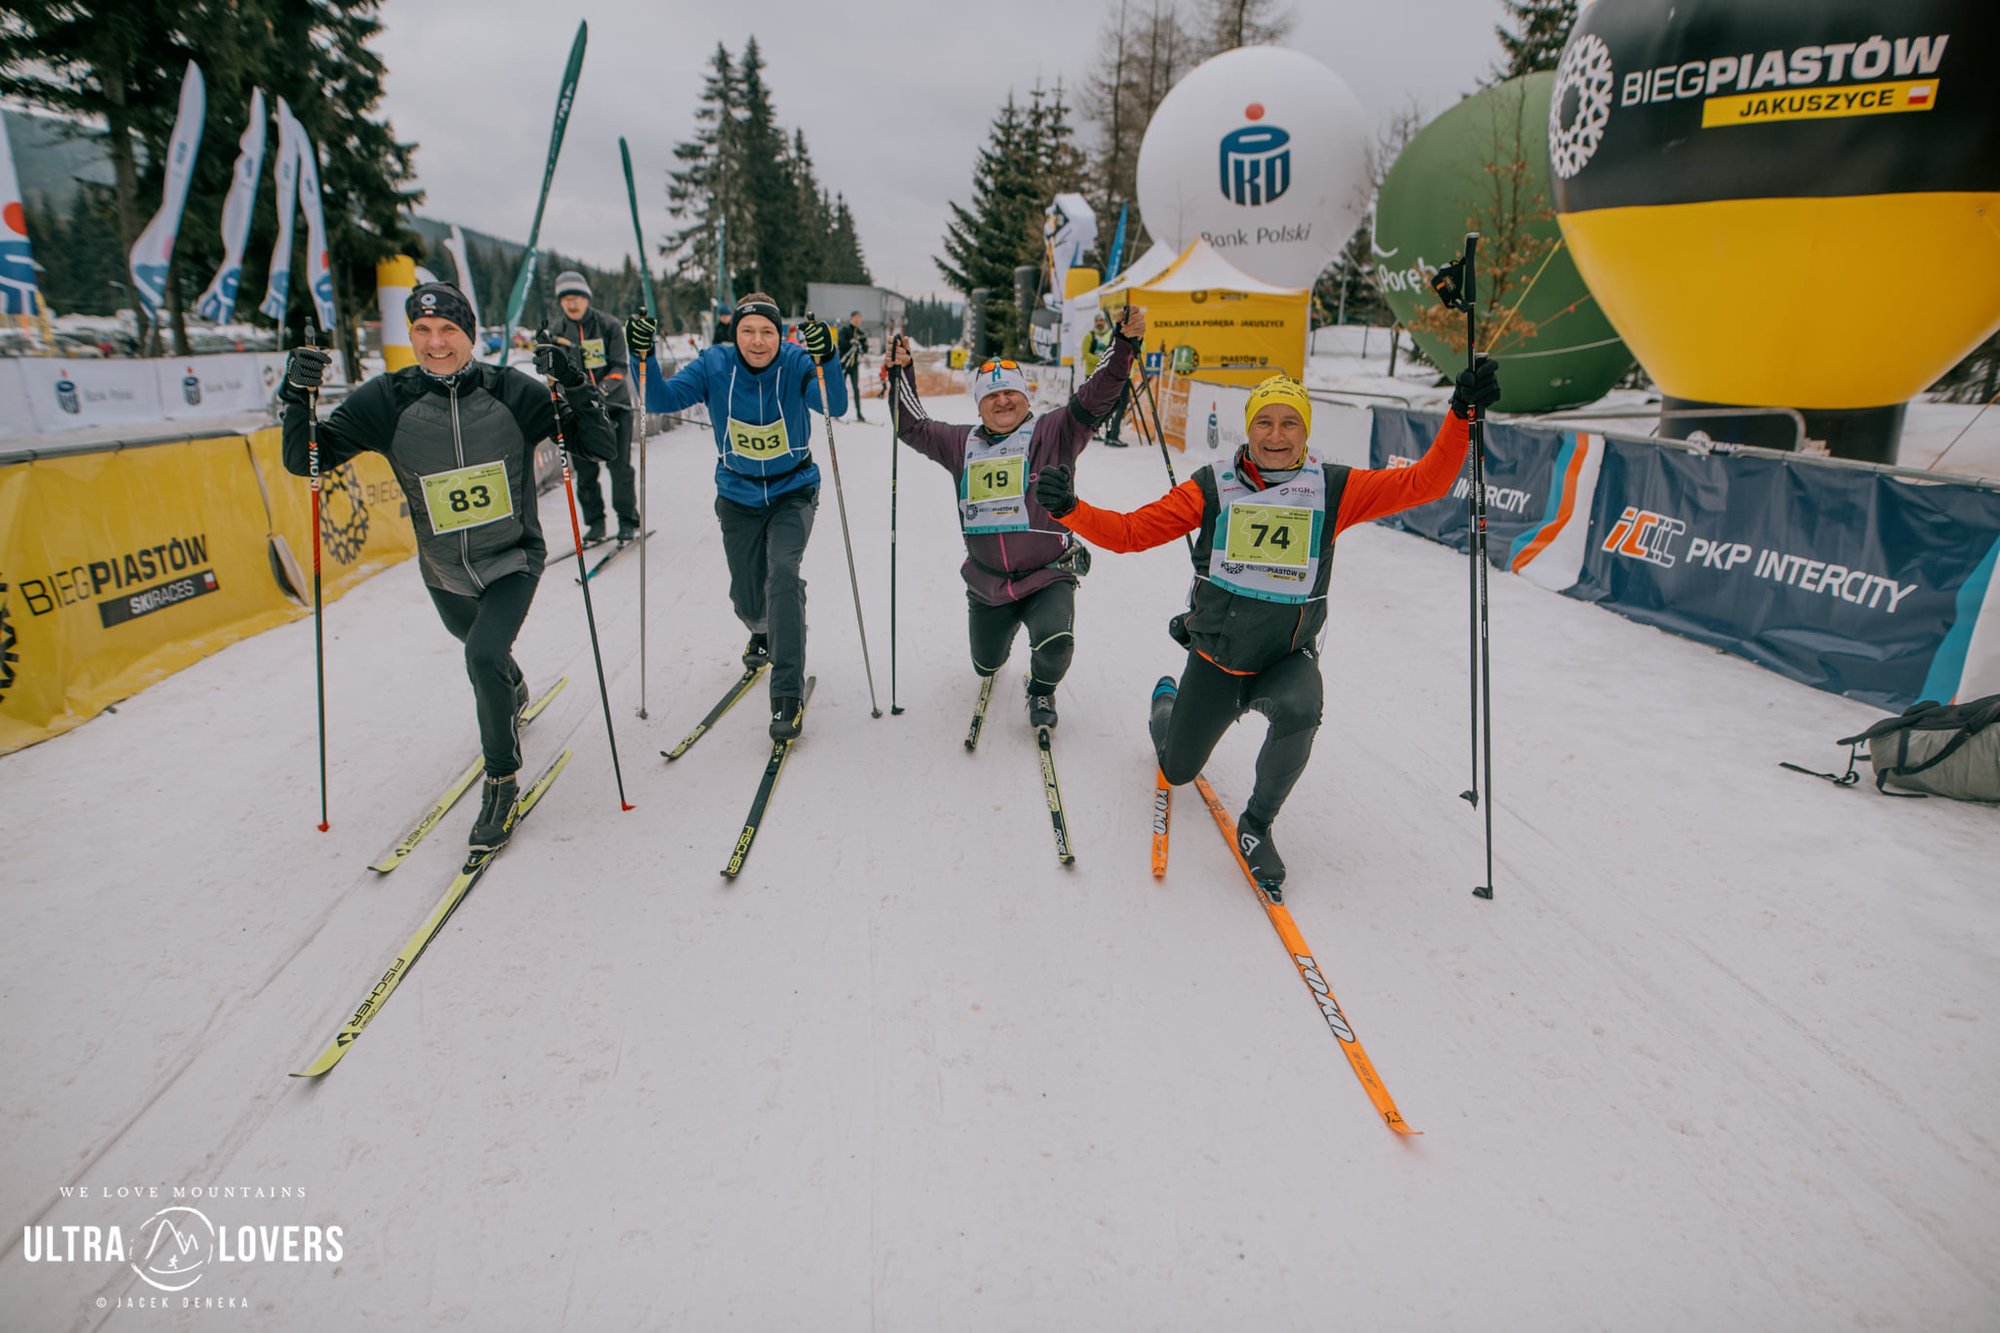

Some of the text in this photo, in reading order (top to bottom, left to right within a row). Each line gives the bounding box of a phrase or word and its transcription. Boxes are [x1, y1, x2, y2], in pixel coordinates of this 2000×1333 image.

[1621, 34, 1949, 107] BIEGPIASTÓW
[1740, 89, 1896, 117] JAKUSZYCE
[1200, 223, 1312, 248] Bank Polski
[1376, 257, 1452, 295] Poręb
[1154, 320, 1285, 328] SZKLARSKA PORĘBA JAKUSZYCE
[736, 433, 780, 451] 203
[982, 471, 1009, 489] 19
[1453, 477, 1531, 515] INRCITY
[448, 485, 491, 513] 83
[1250, 523, 1291, 549] 74
[1685, 537, 1918, 613] PKP INTERCITY
[130, 580, 195, 615] SKIRACES
[404, 805, 443, 846] FISCHER
[727, 825, 755, 874] FISCHER
[346, 957, 405, 1027] FISCHER
